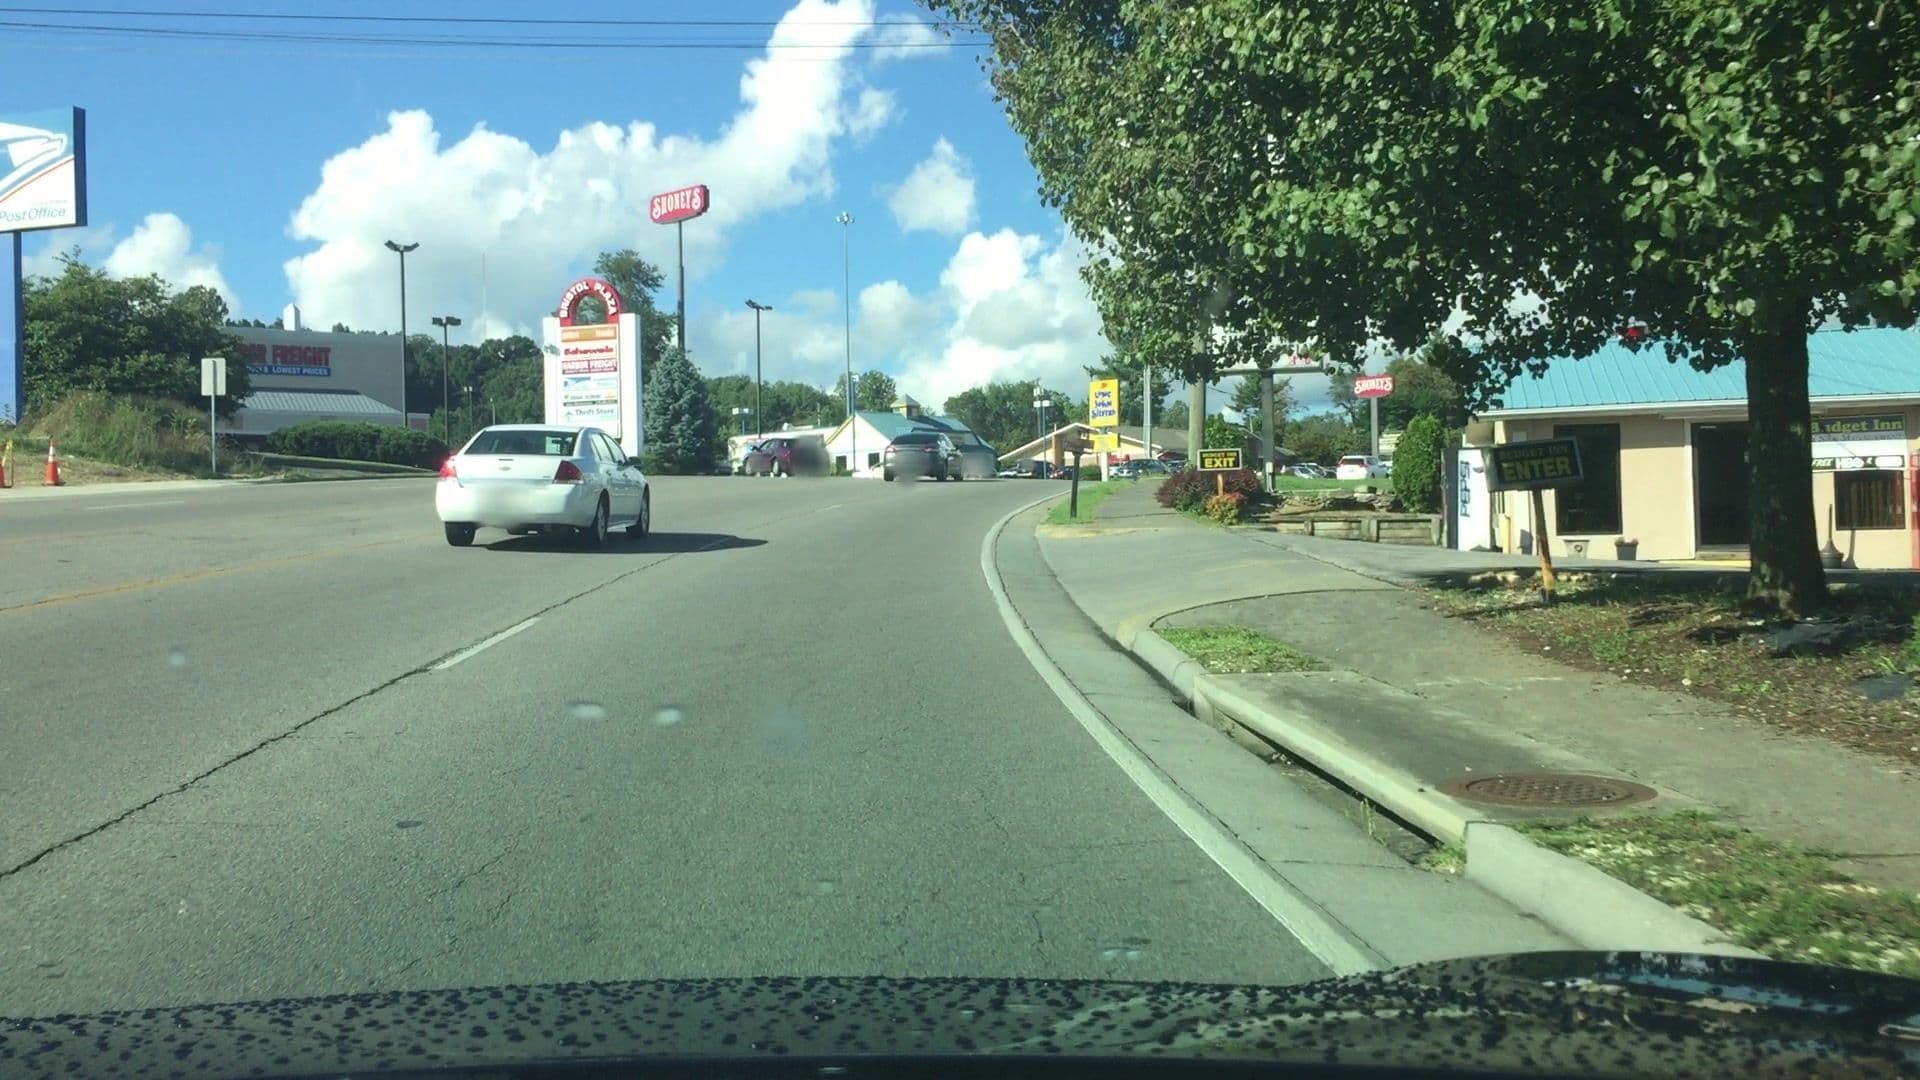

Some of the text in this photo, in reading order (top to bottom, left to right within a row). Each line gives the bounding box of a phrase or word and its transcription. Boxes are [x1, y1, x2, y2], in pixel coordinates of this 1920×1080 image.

[28, 207, 66, 220] Office
[560, 281, 617, 318] BRISTOL PLAZA
[272, 345, 331, 367] FREIGHT
[591, 359, 617, 369] FREIGHT
[272, 366, 301, 375] LOWEST
[302, 367, 329, 376] PRICES
[576, 408, 594, 416] Thrift
[1873, 419, 1904, 431] Inn
[1205, 457, 1235, 468] EXIT
[1502, 456, 1571, 481] ENTER
[1811, 458, 1833, 467] FREE
[1460, 460, 1471, 518] PEPSI
